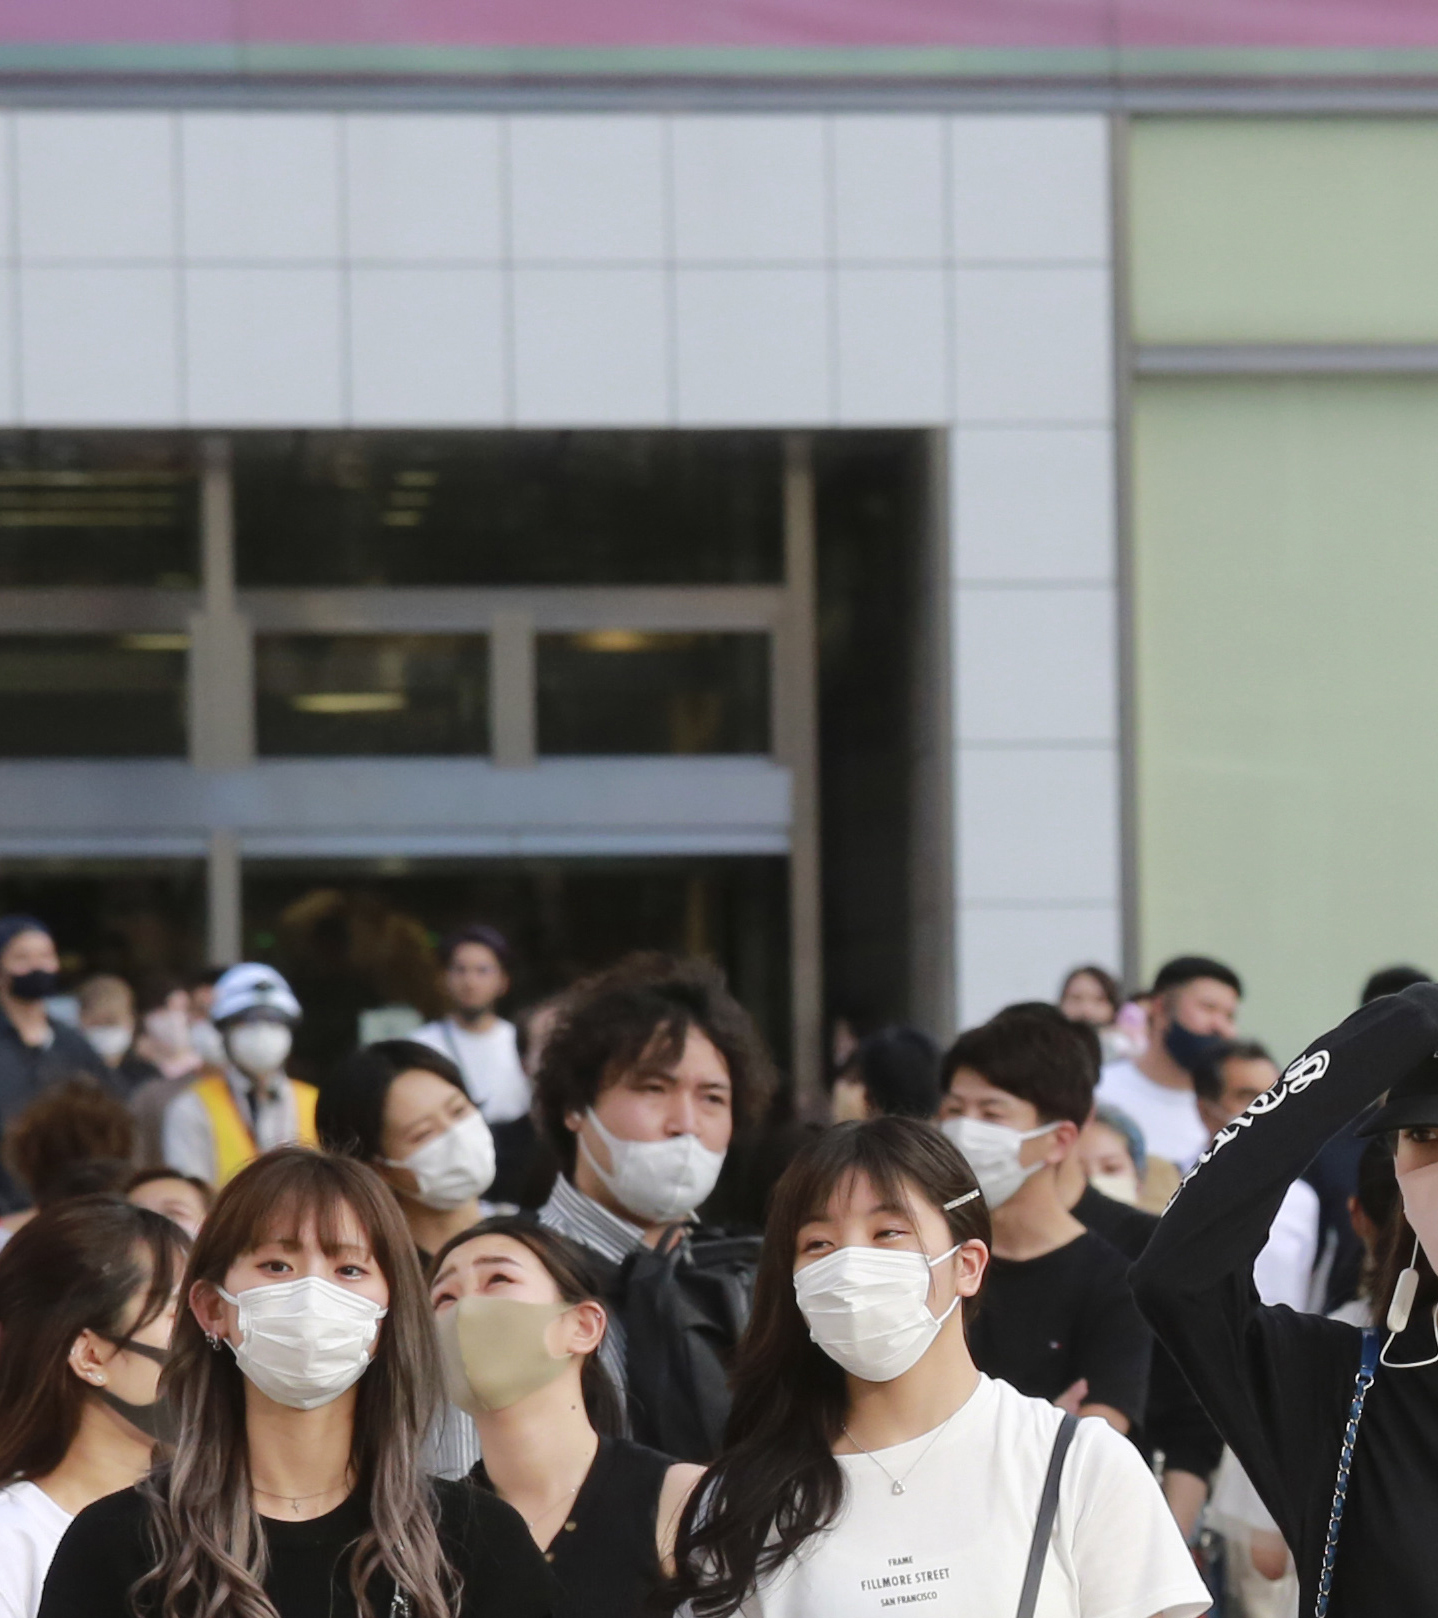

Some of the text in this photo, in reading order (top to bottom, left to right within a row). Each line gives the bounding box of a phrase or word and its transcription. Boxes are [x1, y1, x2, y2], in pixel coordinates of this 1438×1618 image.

[888, 1555, 914, 1567] FRAME
[861, 1567, 950, 1591] FILLMORE STREET
[880, 1591, 938, 1607] SAN FRANCISCO
